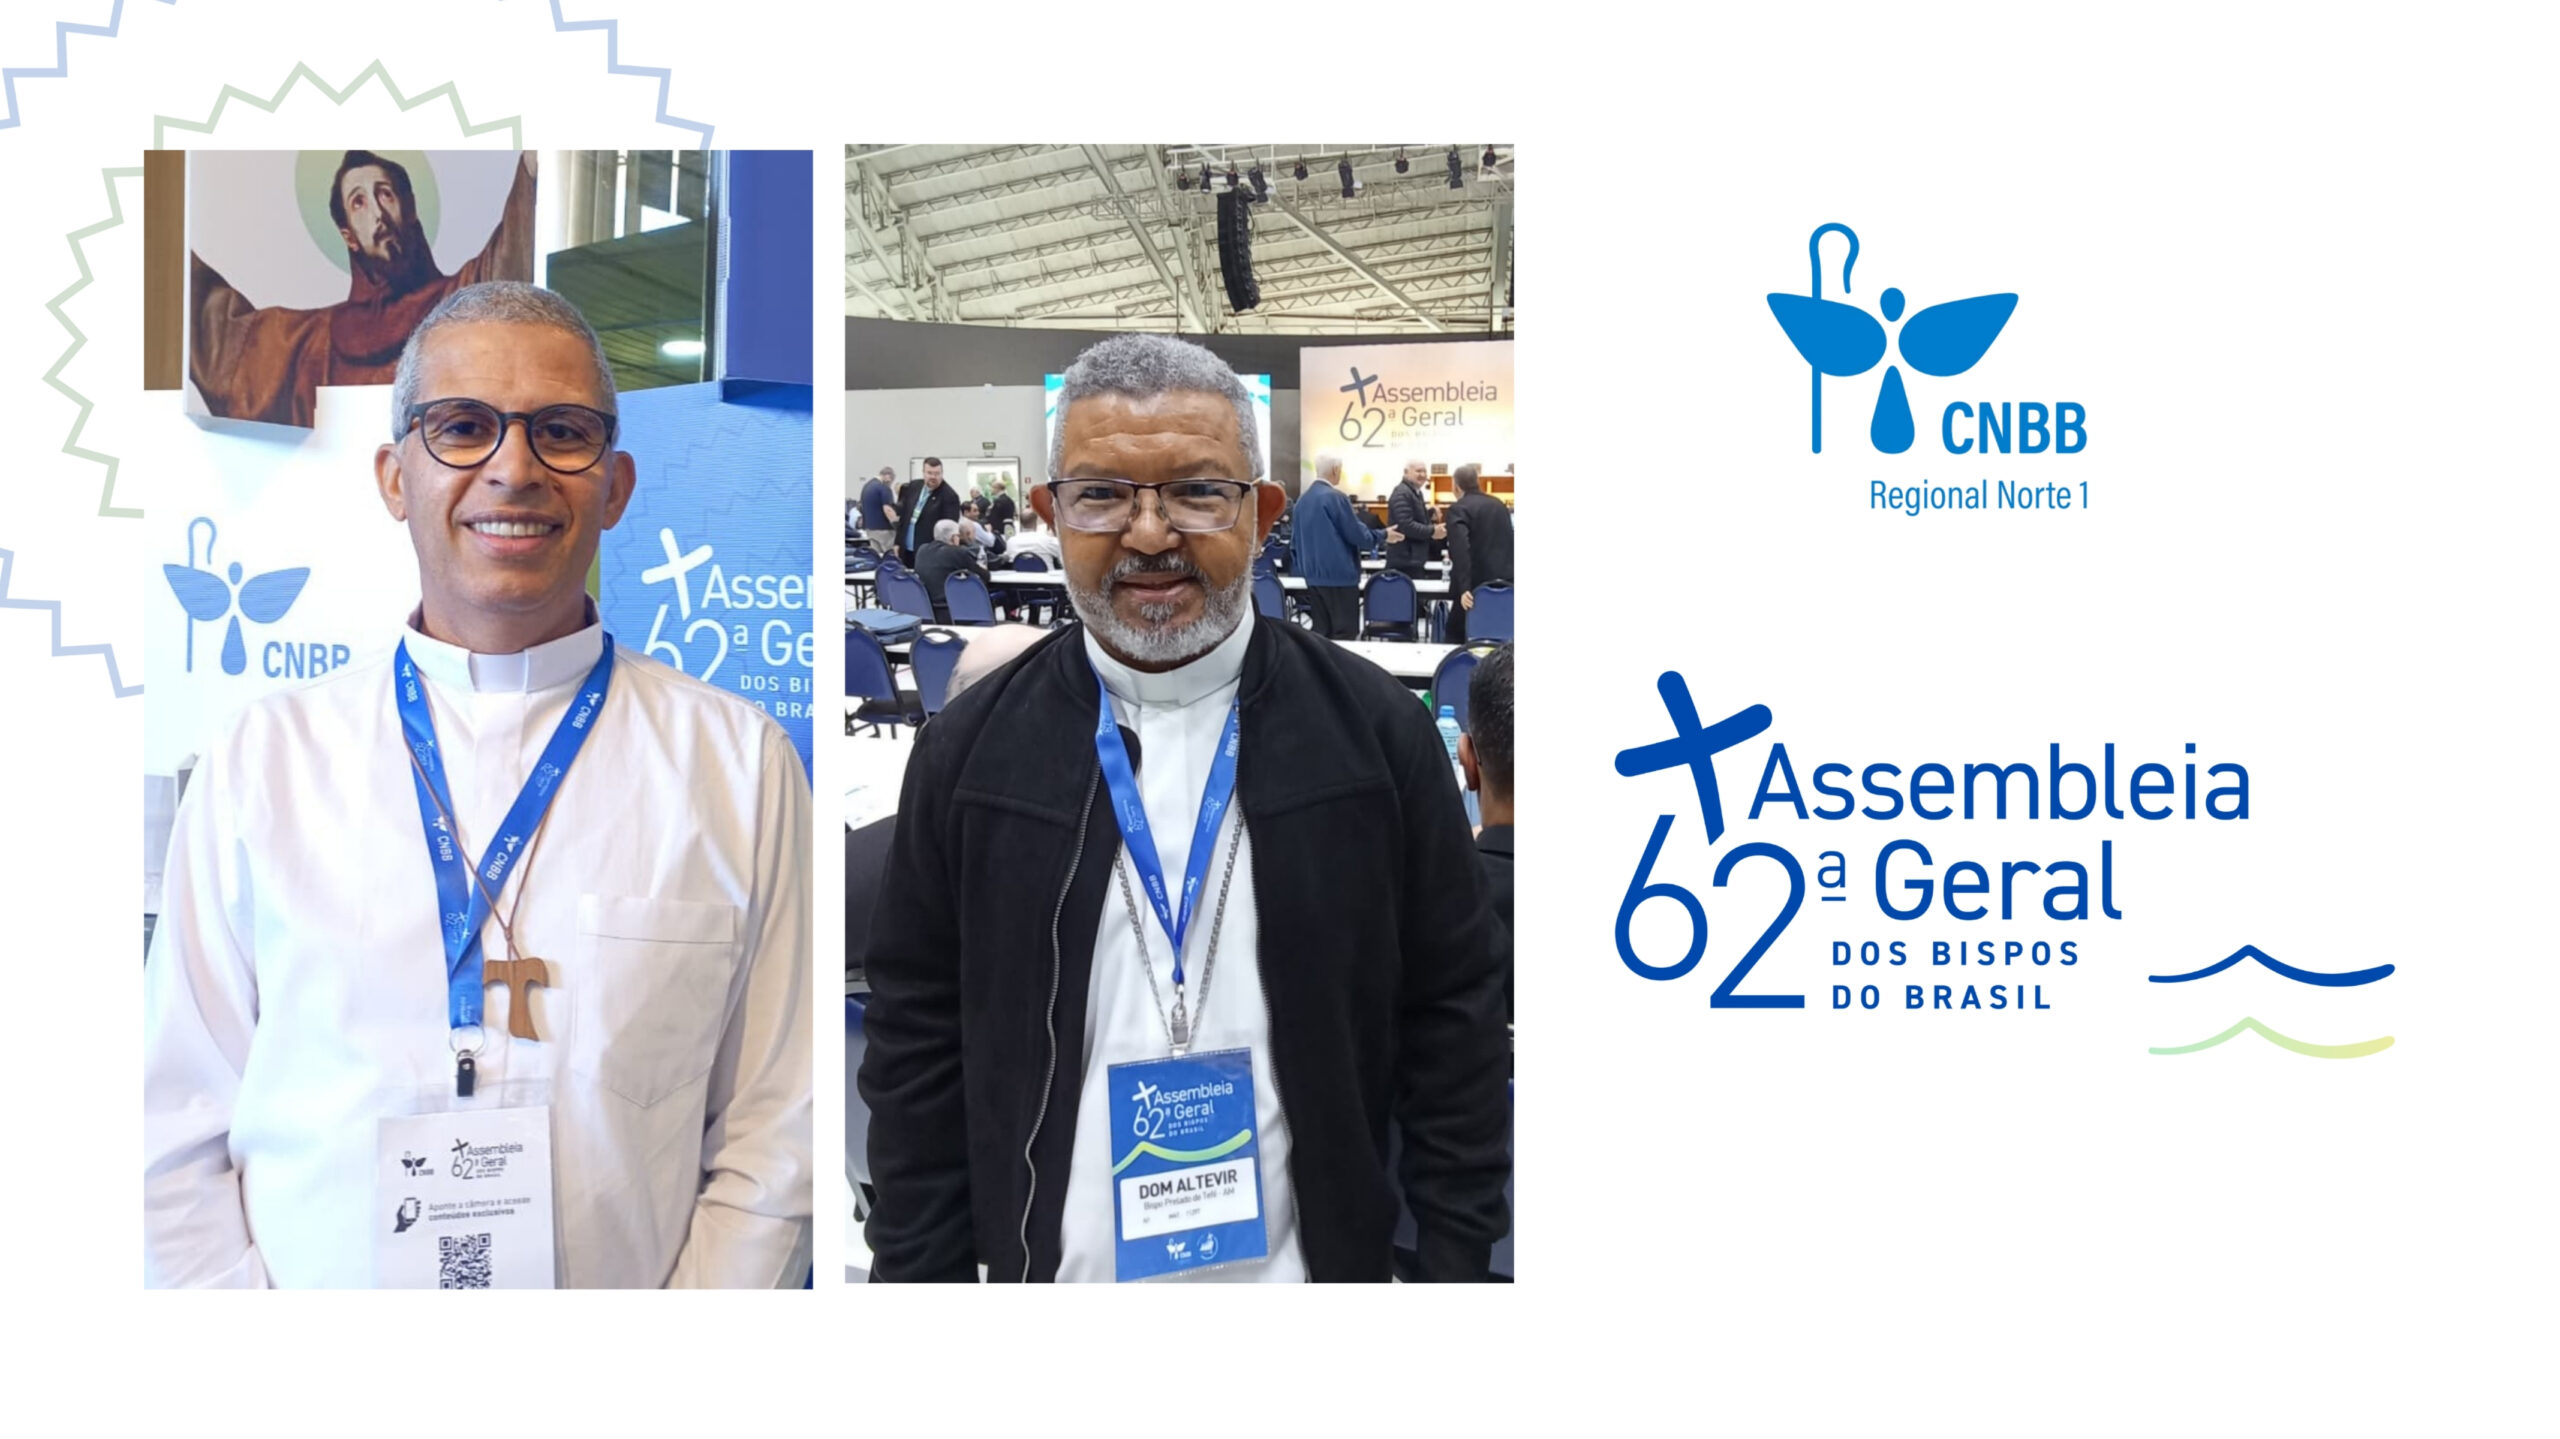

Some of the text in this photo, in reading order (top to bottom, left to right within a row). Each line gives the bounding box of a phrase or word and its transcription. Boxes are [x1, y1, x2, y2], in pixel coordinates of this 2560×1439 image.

[1372, 381, 1498, 403] Assembleia
[1402, 406, 1464, 427] Geral
[740, 675, 780, 691] DOS
[572, 706, 591, 729] CNBB
[438, 835, 453, 862] CNBB
[486, 852, 508, 880] CNBB
[1154, 1080, 1234, 1106] Assembleia
[1174, 1099, 1214, 1119] Geral
[466, 1142, 523, 1156] Assembleia
[480, 1156, 507, 1168] Geral
[1139, 1169, 1238, 1200] DOM ALTEVIR
